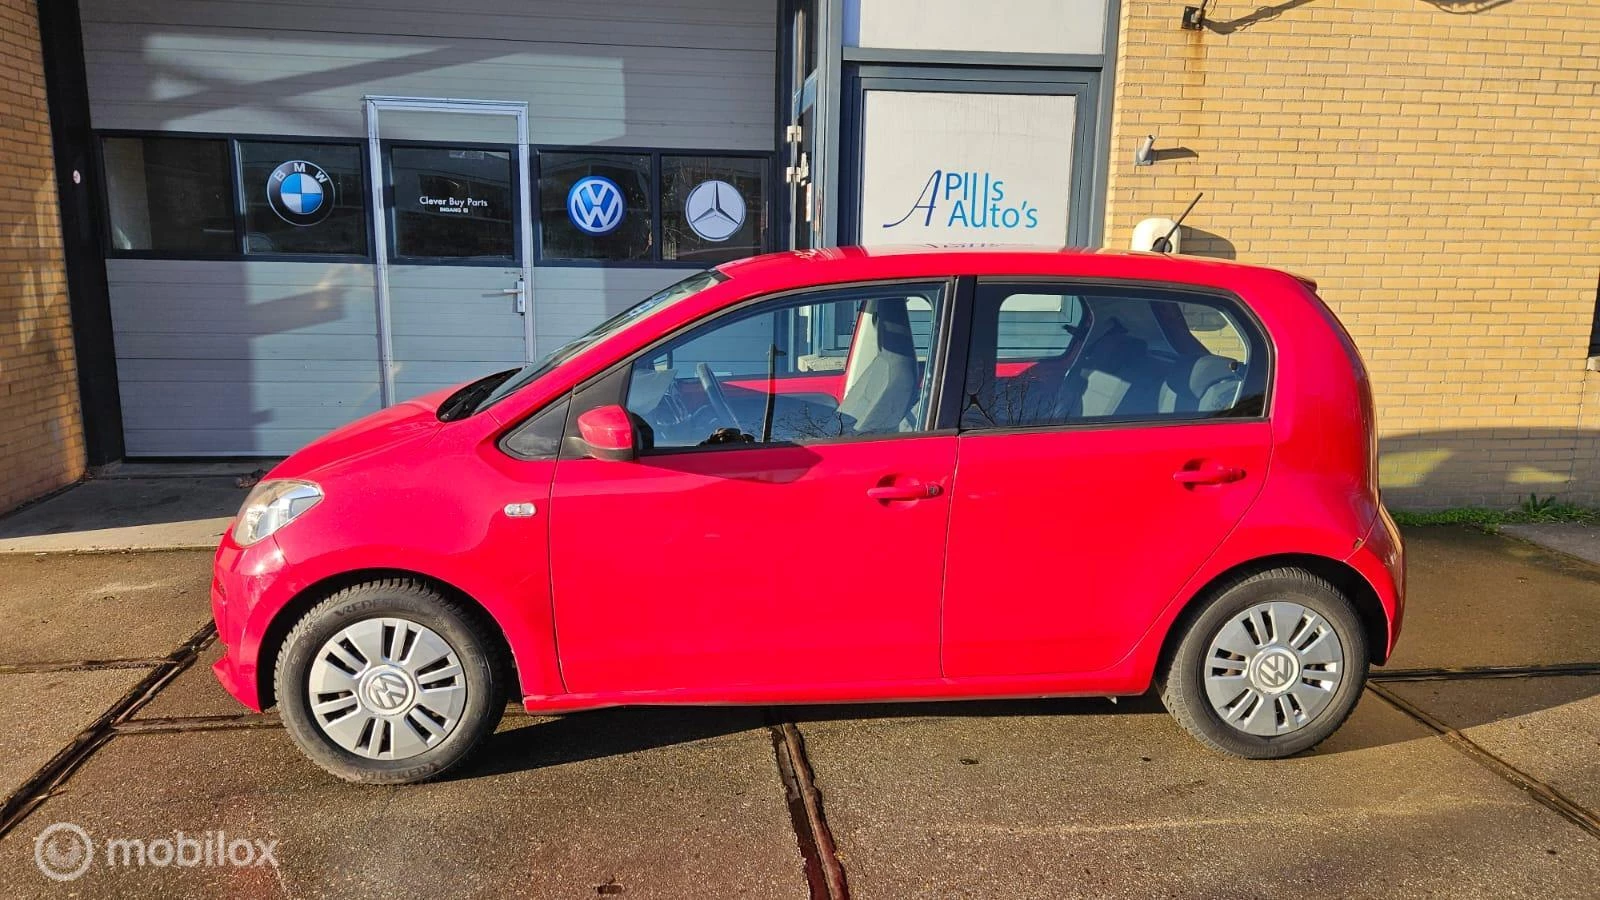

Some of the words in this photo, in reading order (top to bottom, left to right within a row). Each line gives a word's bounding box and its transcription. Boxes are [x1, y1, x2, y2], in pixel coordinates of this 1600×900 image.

[274, 162, 328, 184] BMW
[419, 196, 447, 205] Clever
[449, 197, 464, 207] Buy
[467, 198, 488, 207] Parts
[569, 178, 625, 234] VW
